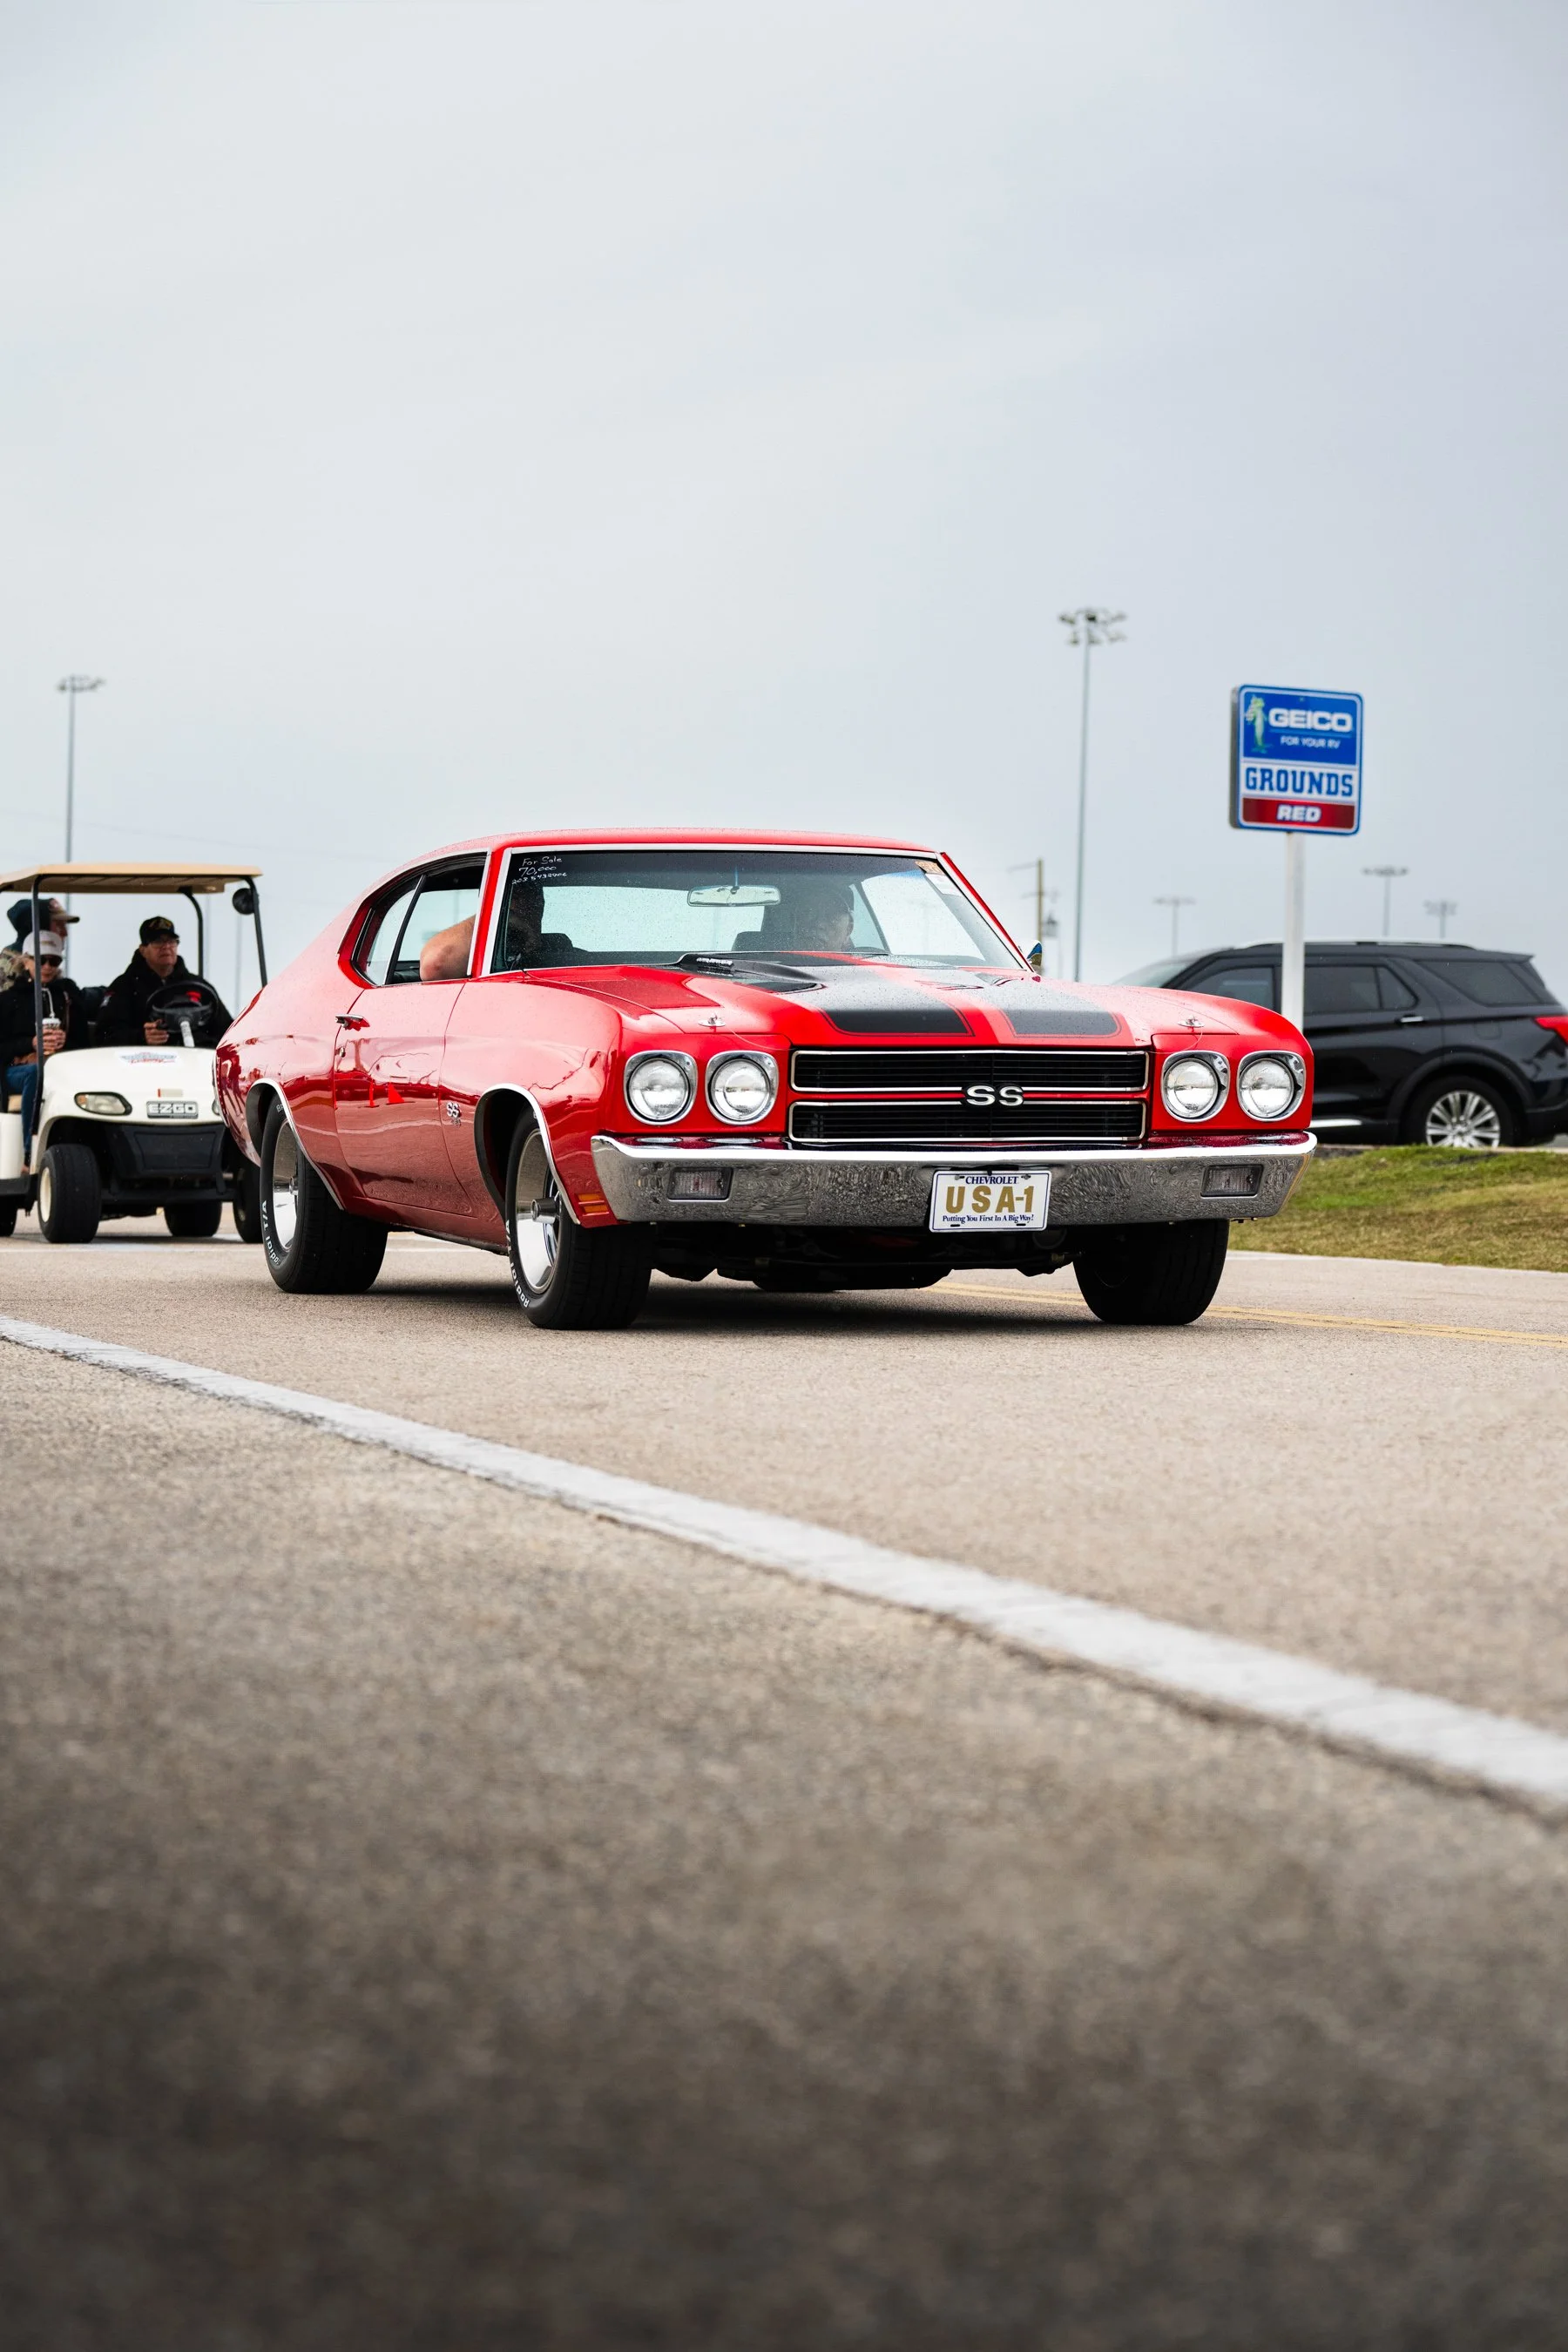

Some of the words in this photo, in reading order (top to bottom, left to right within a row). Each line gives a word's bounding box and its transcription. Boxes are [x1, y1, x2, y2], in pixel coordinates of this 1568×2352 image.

[1268, 707, 1353, 733] GEICO
[1281, 735, 1300, 746] FOR
[1301, 737, 1326, 747] YOUR
[1327, 739, 1342, 749] RV
[1245, 767, 1353, 797] GROUNDS
[1276, 804, 1321, 822] RED
[522, 858, 538, 867] For
[518, 867, 557, 877] 70,000
[966, 1085, 1024, 1106] SS
[447, 1102, 460, 1118] SS
[943, 1215, 966, 1224] Putting
[1009, 1214, 1019, 1224] Big
[1019, 1213, 1035, 1223] Way!
